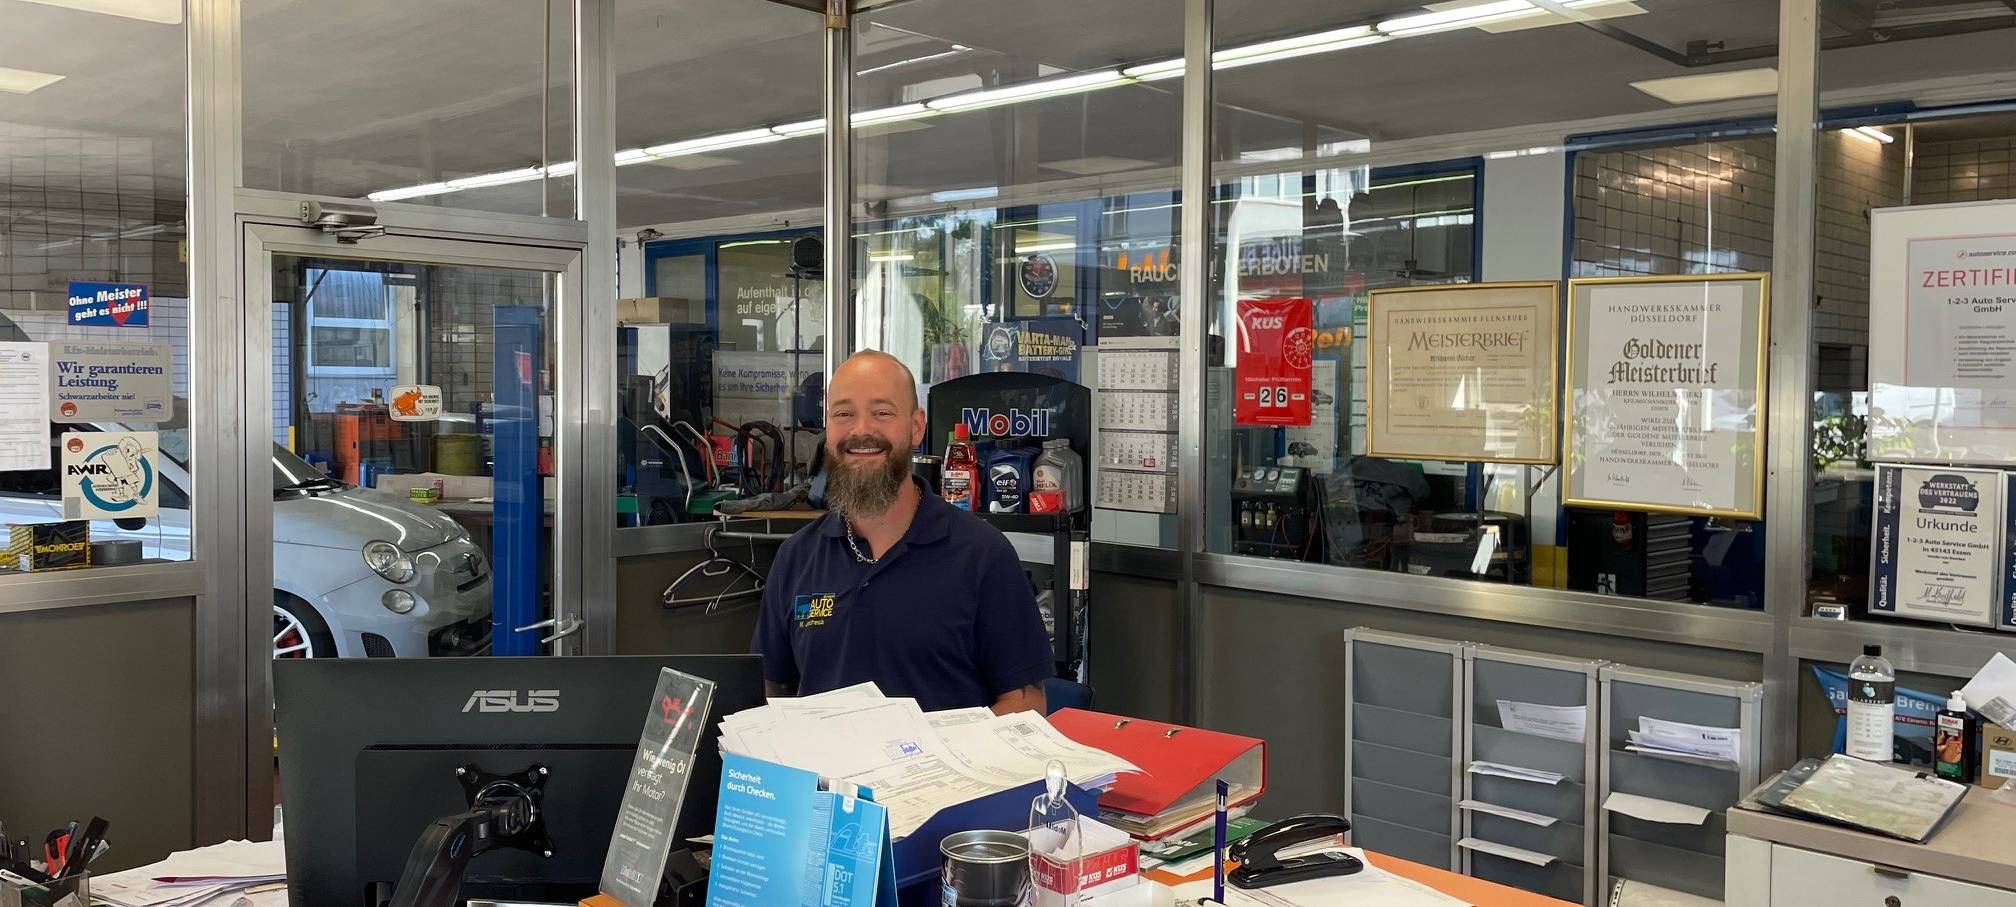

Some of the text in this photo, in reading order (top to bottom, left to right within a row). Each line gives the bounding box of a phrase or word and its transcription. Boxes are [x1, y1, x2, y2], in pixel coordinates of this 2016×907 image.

[1238, 253, 1329, 277] ERBOTEN
[69, 288, 142, 307] Ohne Meister
[737, 286, 787, 299] Aufenthalt
[737, 300, 752, 314] auf
[1947, 297, 1969, 305] 1-2-3
[1971, 297, 1993, 305] Auto
[75, 300, 147, 321] geht es nicht !!!
[1973, 305, 2002, 313] GmbH
[1251, 316, 1283, 330] KÜS
[1480, 314, 1528, 323] FLENSBURG
[1631, 314, 1698, 323] DÜSSELDORF
[1016, 330, 1071, 345] VARTA-MAN
[1623, 337, 1702, 360] Goldener
[57, 361, 163, 378] Wir garantieren
[718, 368, 736, 378] Keine
[58, 376, 119, 391] Leistung.
[1612, 389, 1640, 398] HERRN
[962, 408, 1049, 436] Mobil
[1627, 432, 1660, 440] GOLDENE
[67, 464, 109, 475] AWR
[1036, 481, 1057, 489] HELIX
[1883, 469, 1893, 514] Kompetenz.
[1929, 481, 1969, 490] WERKSTATT
[1934, 490, 1978, 499] VERTRAUENS
[1939, 497, 1957, 505] 2022
[1916, 517, 1978, 533] Urkunde
[1881, 524, 1891, 564] Sicherheit.
[1924, 538, 1941, 546] Auto
[1942, 540, 1967, 548] Service
[1967, 542, 1990, 550] GmbH
[1878, 575, 1888, 607] Qualität.
[810, 598, 834, 609] AUTO
[807, 608, 833, 618] SERVICE
[461, 689, 560, 713] ASUS
[642, 748, 656, 762] Wie
[676, 759, 687, 775] Öl
[728, 768, 761, 785] Sicherheit
[632, 779, 666, 802] Ihr Motor?
[727, 781, 776, 800] durch Checken.
[834, 869, 853, 883] DOT
[833, 881, 844, 895] 5.1
